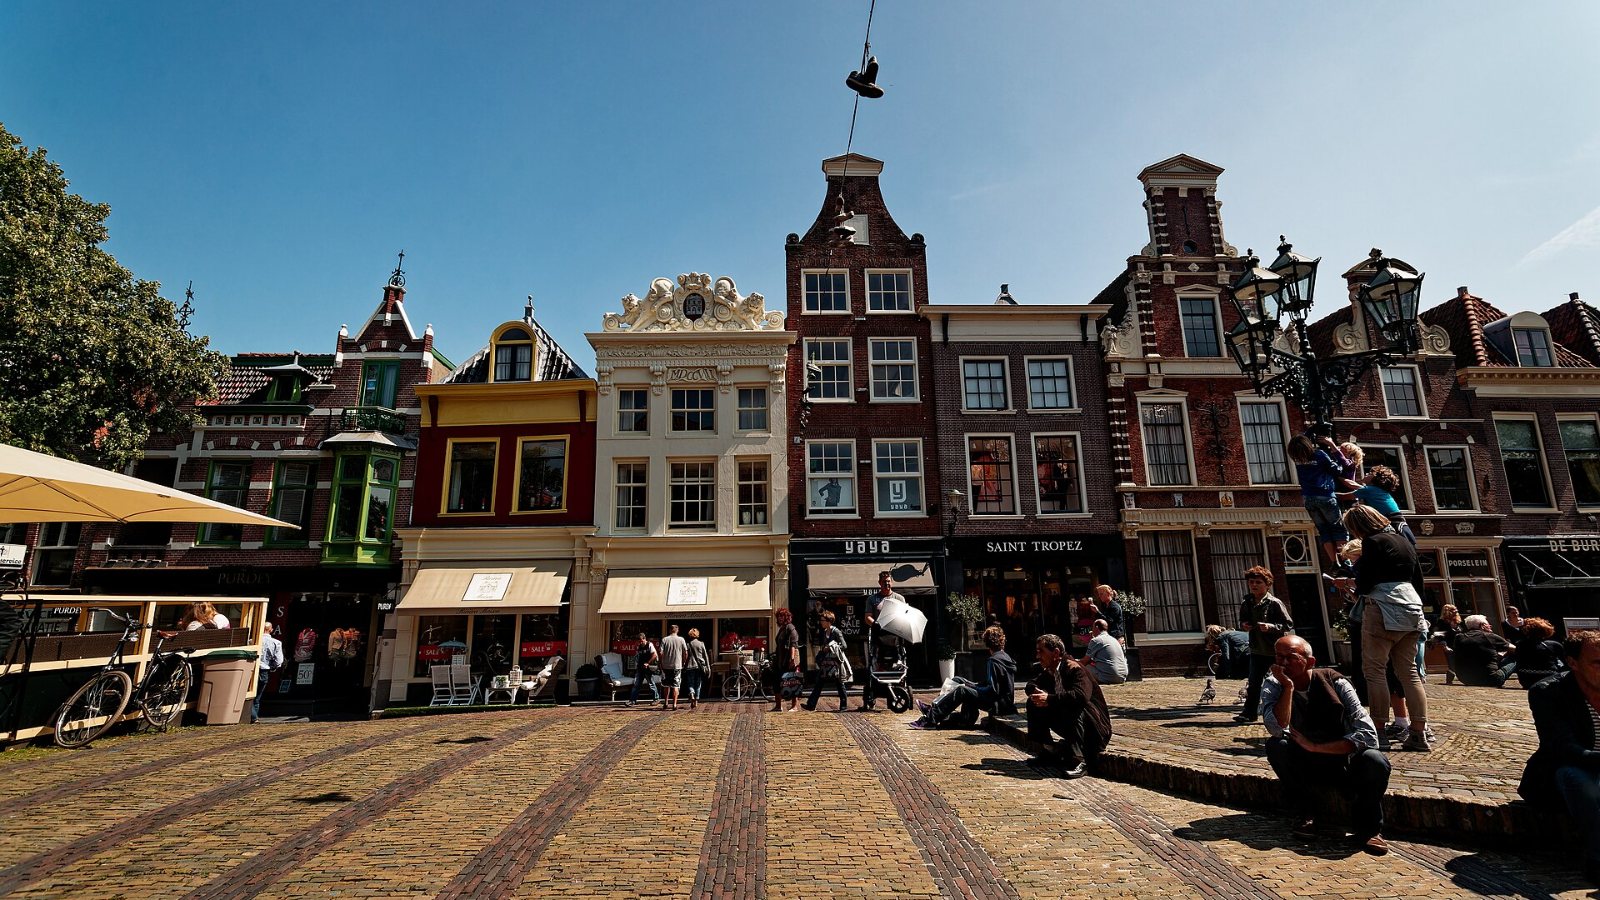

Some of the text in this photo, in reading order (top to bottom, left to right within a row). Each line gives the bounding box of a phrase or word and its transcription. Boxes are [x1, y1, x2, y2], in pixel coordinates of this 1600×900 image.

[845, 541, 890, 554] yaya
[986, 540, 1083, 552] SAINT TROPEZ
[1549, 539, 1600, 552] DE BUR
[1448, 559, 1488, 567] PORSELEIN
[841, 619, 860, 628] SALE
